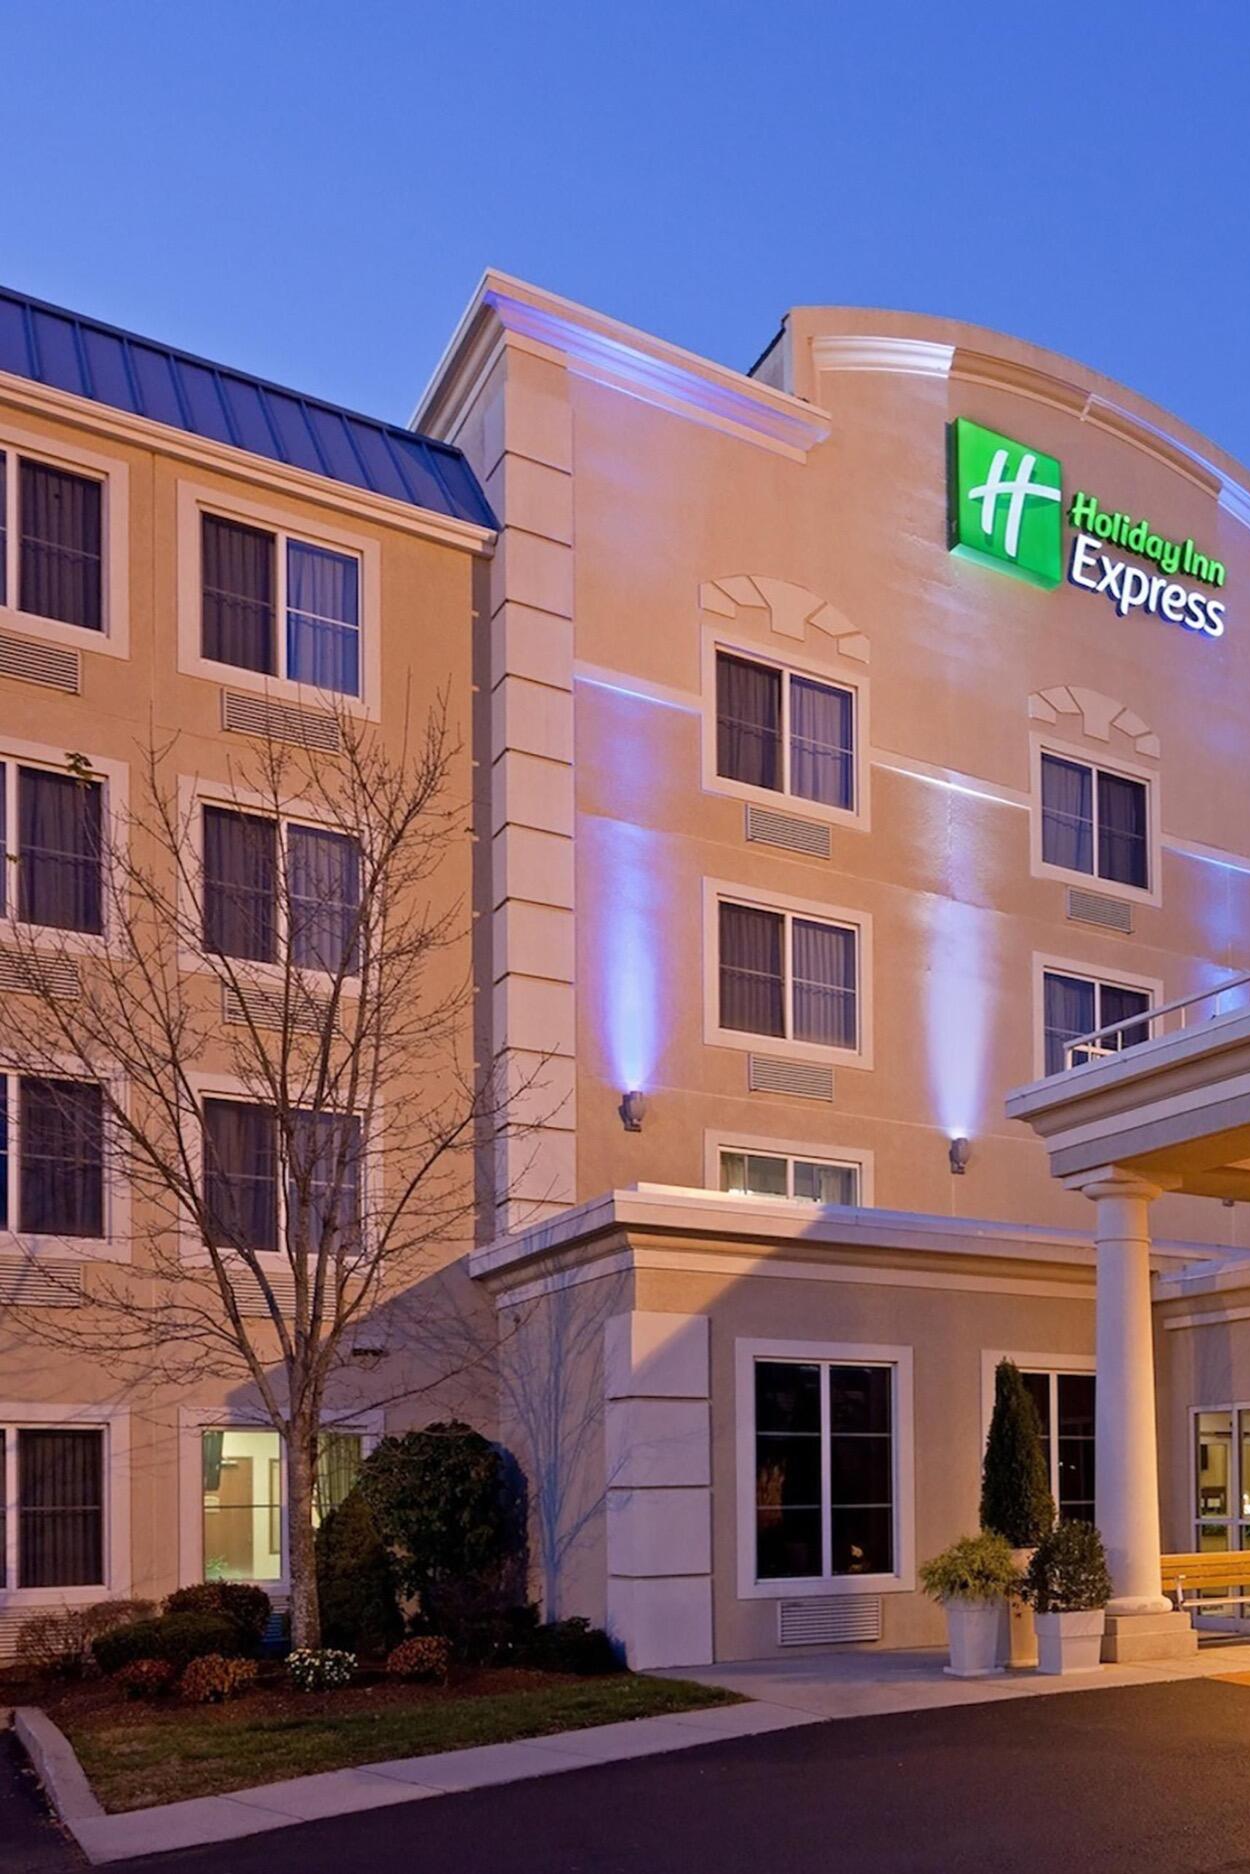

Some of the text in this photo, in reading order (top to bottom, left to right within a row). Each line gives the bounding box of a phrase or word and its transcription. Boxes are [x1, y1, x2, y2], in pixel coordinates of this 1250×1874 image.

[968, 449, 1061, 558] H
[1071, 491, 1226, 587] Holiday Inn
[1071, 533, 1226, 637] Express
